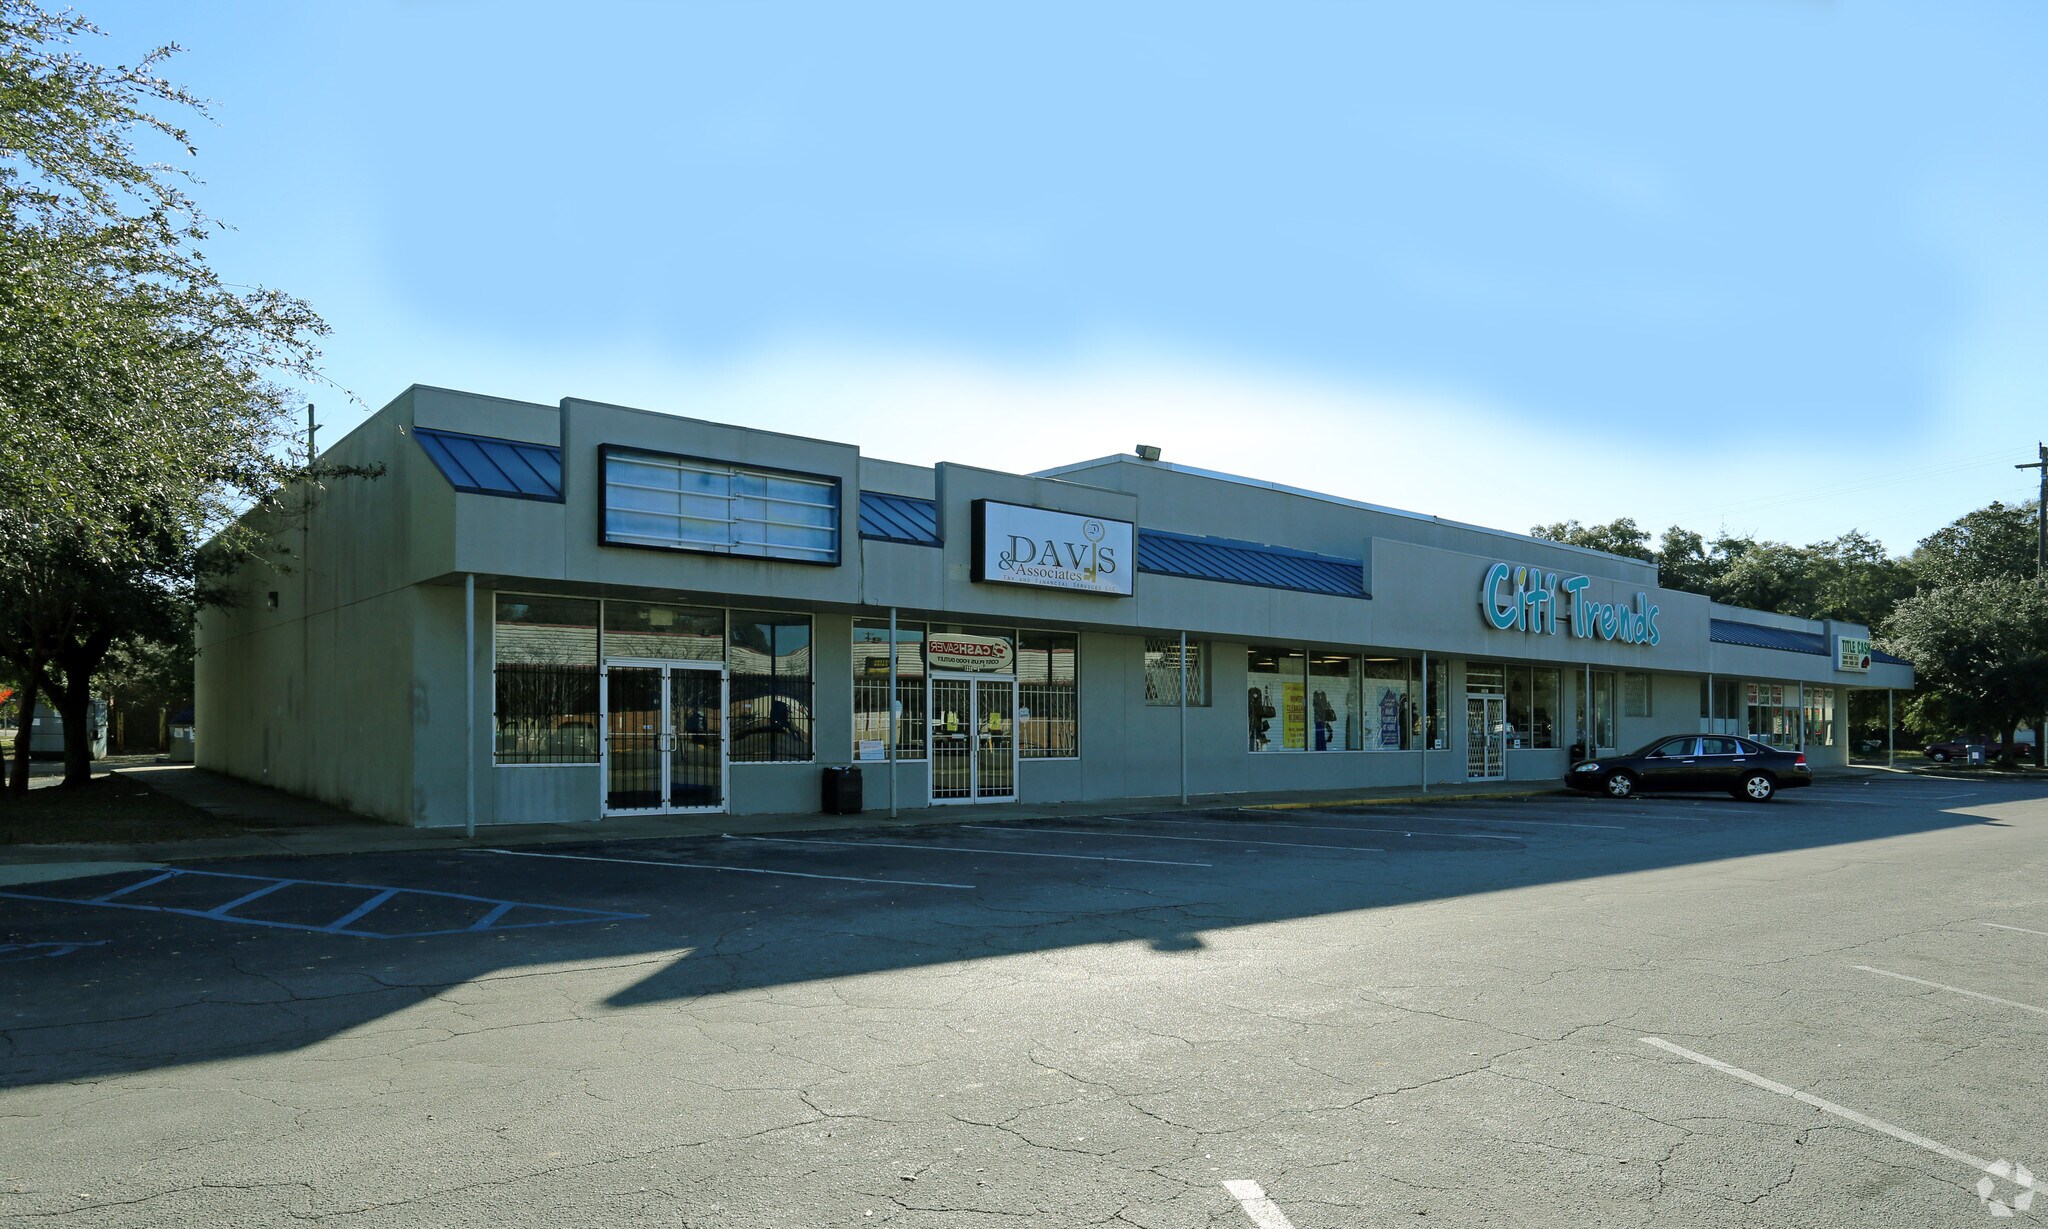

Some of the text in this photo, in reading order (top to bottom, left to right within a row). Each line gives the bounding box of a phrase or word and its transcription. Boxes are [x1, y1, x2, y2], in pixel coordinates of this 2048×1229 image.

[998, 550, 1082, 582] & Associates
[1007, 534, 1116, 575] DAVIS
[1484, 563, 1660, 646] Citi Trends
[1842, 640, 1856, 653] TITLE
